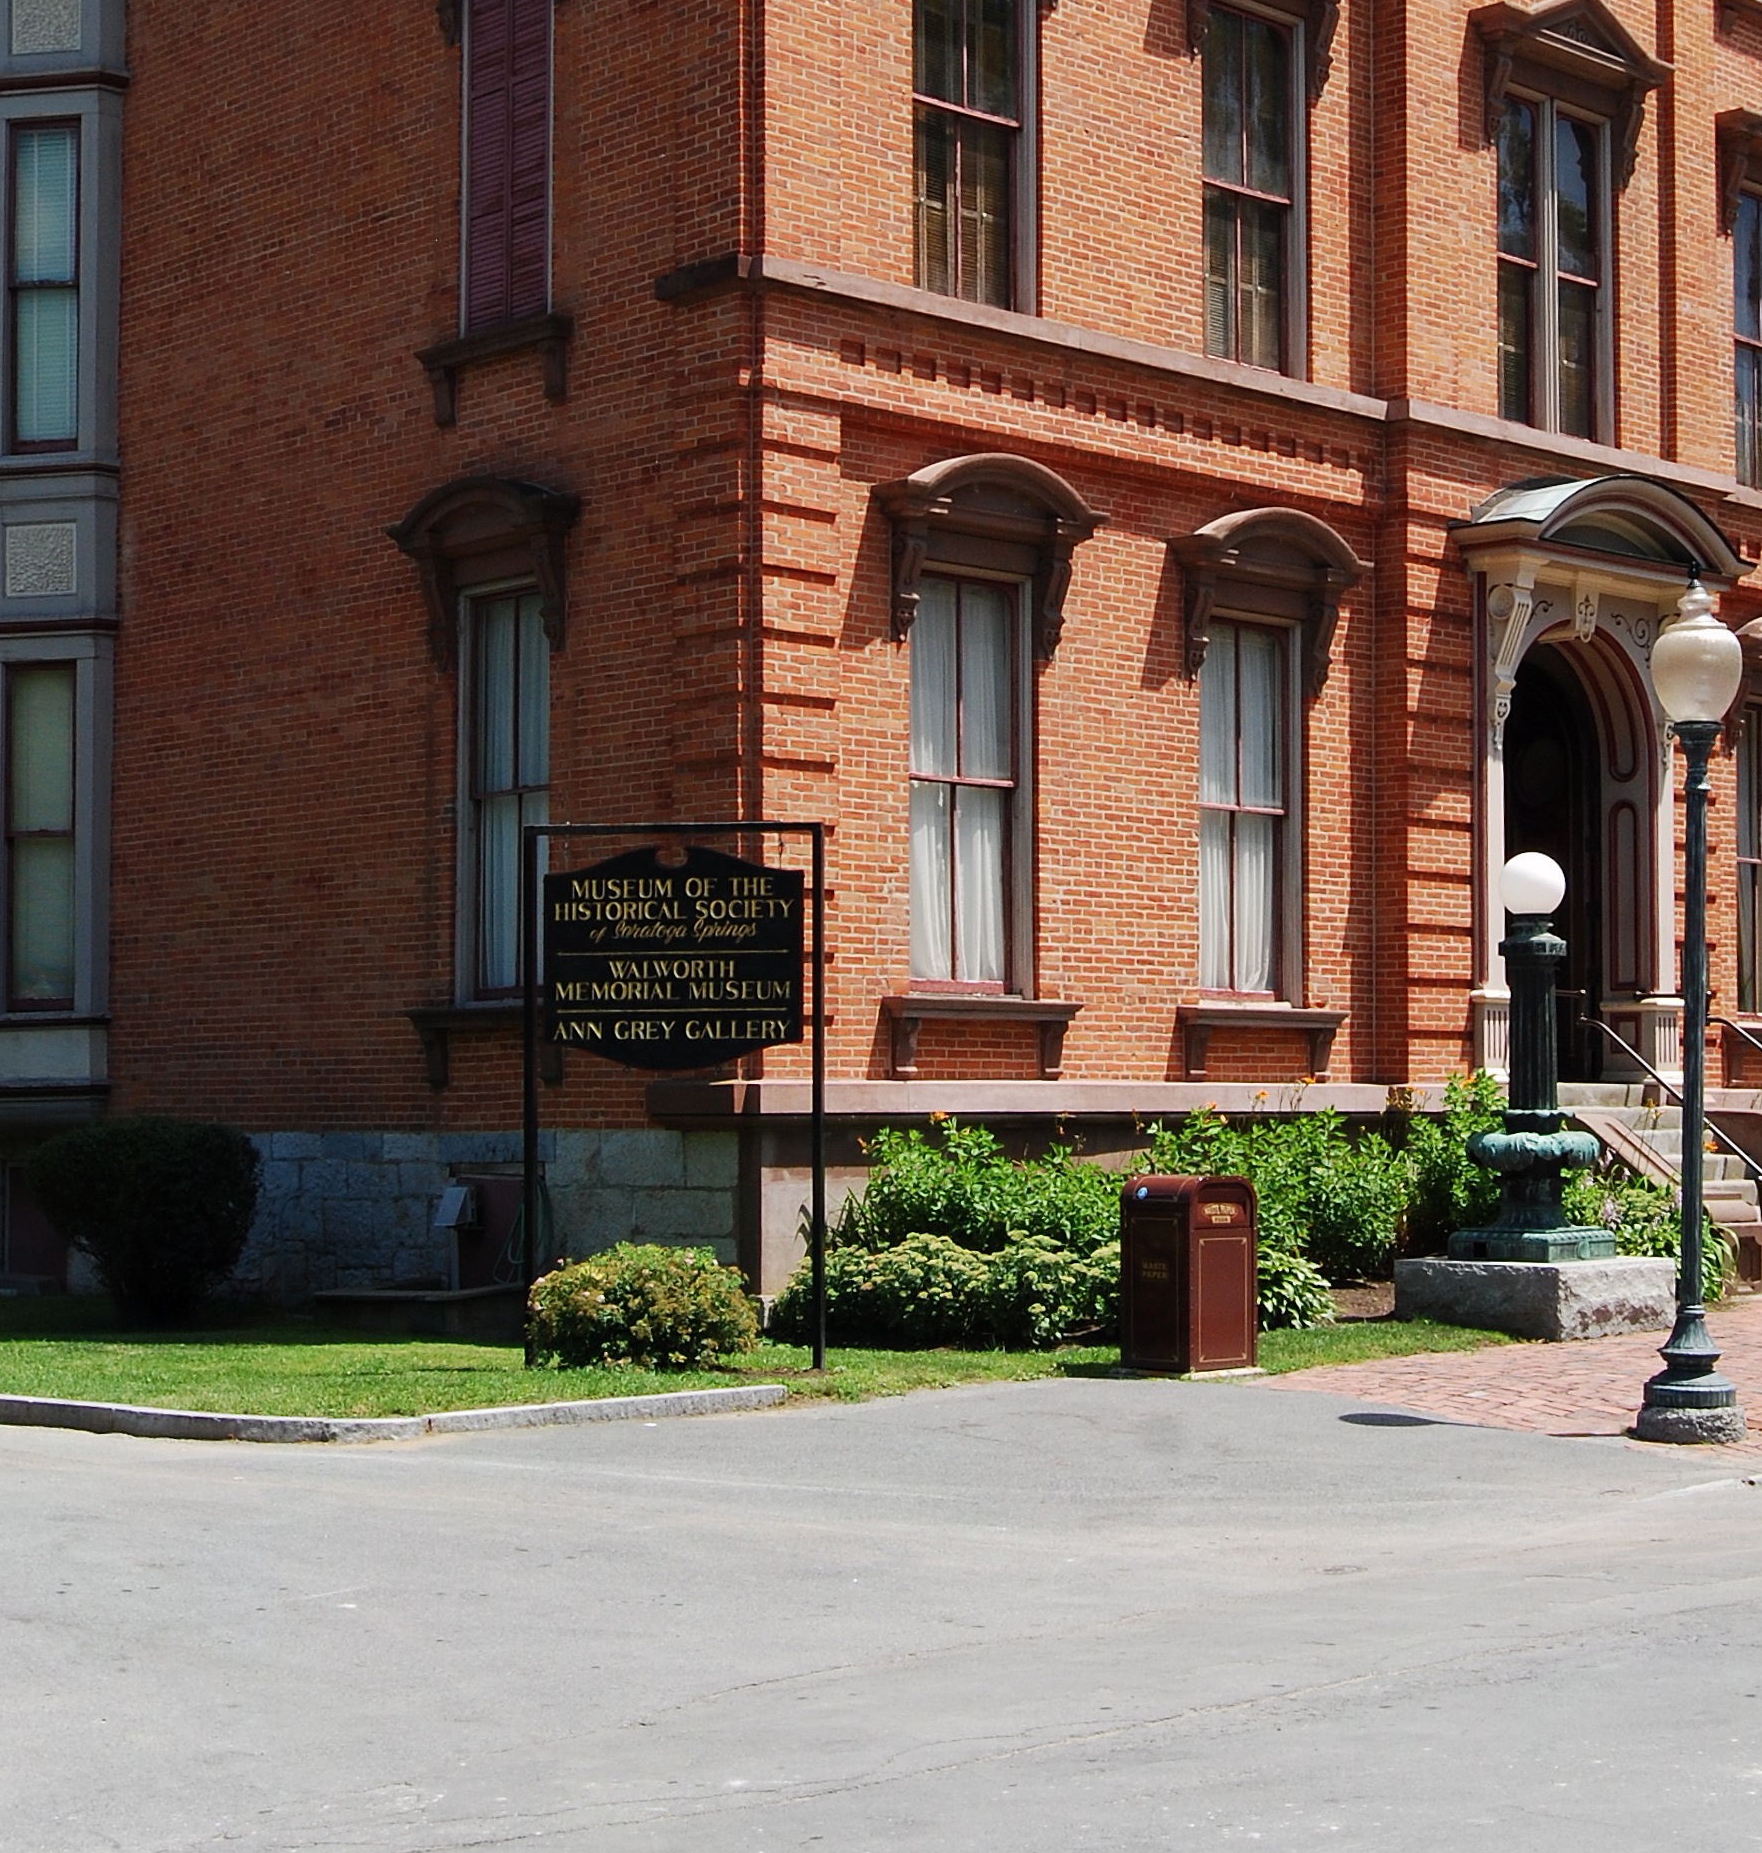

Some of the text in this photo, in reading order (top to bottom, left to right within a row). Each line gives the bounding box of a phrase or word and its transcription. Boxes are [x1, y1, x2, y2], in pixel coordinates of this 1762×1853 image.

[571, 876, 774, 900] MUSEUM OF THE
[554, 899, 794, 921] HISTORICAL SOCIETY
[589, 918, 758, 945] of Saratoga Springs
[608, 959, 735, 980] WALWORTH
[555, 980, 791, 1001] MEMORIAL MUSEUM
[553, 1020, 791, 1041] ANN GREY GALLERY
